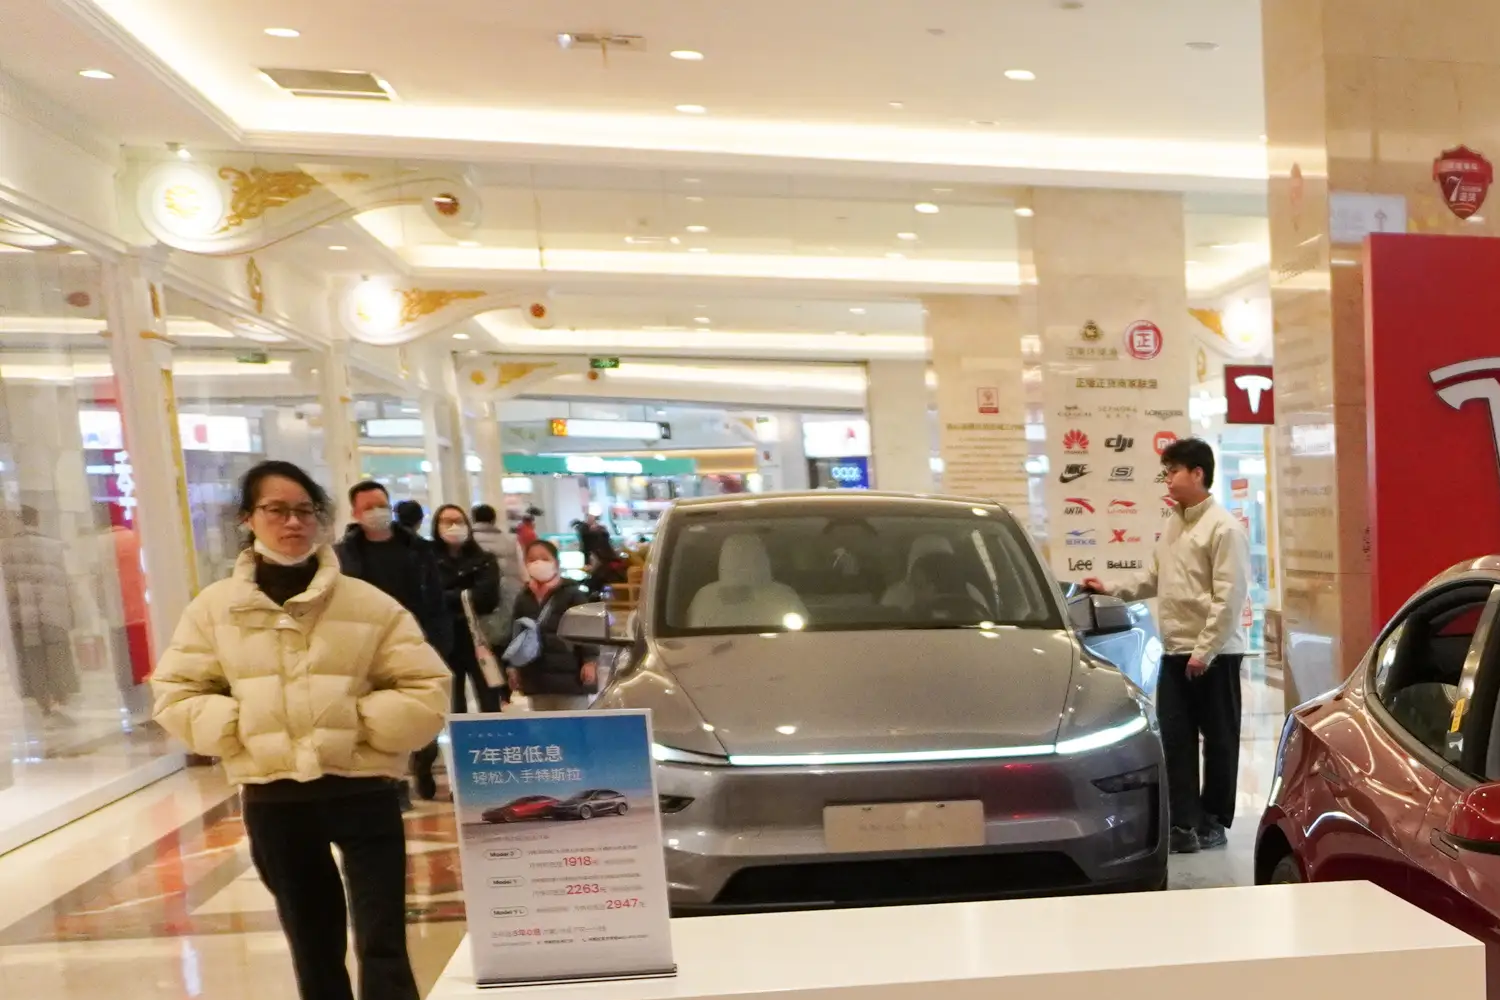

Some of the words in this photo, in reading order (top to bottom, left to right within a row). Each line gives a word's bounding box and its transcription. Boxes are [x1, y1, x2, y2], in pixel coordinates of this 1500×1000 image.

[1068, 557, 1093, 571] Lee
[468, 744, 563, 765] 7年超低息
